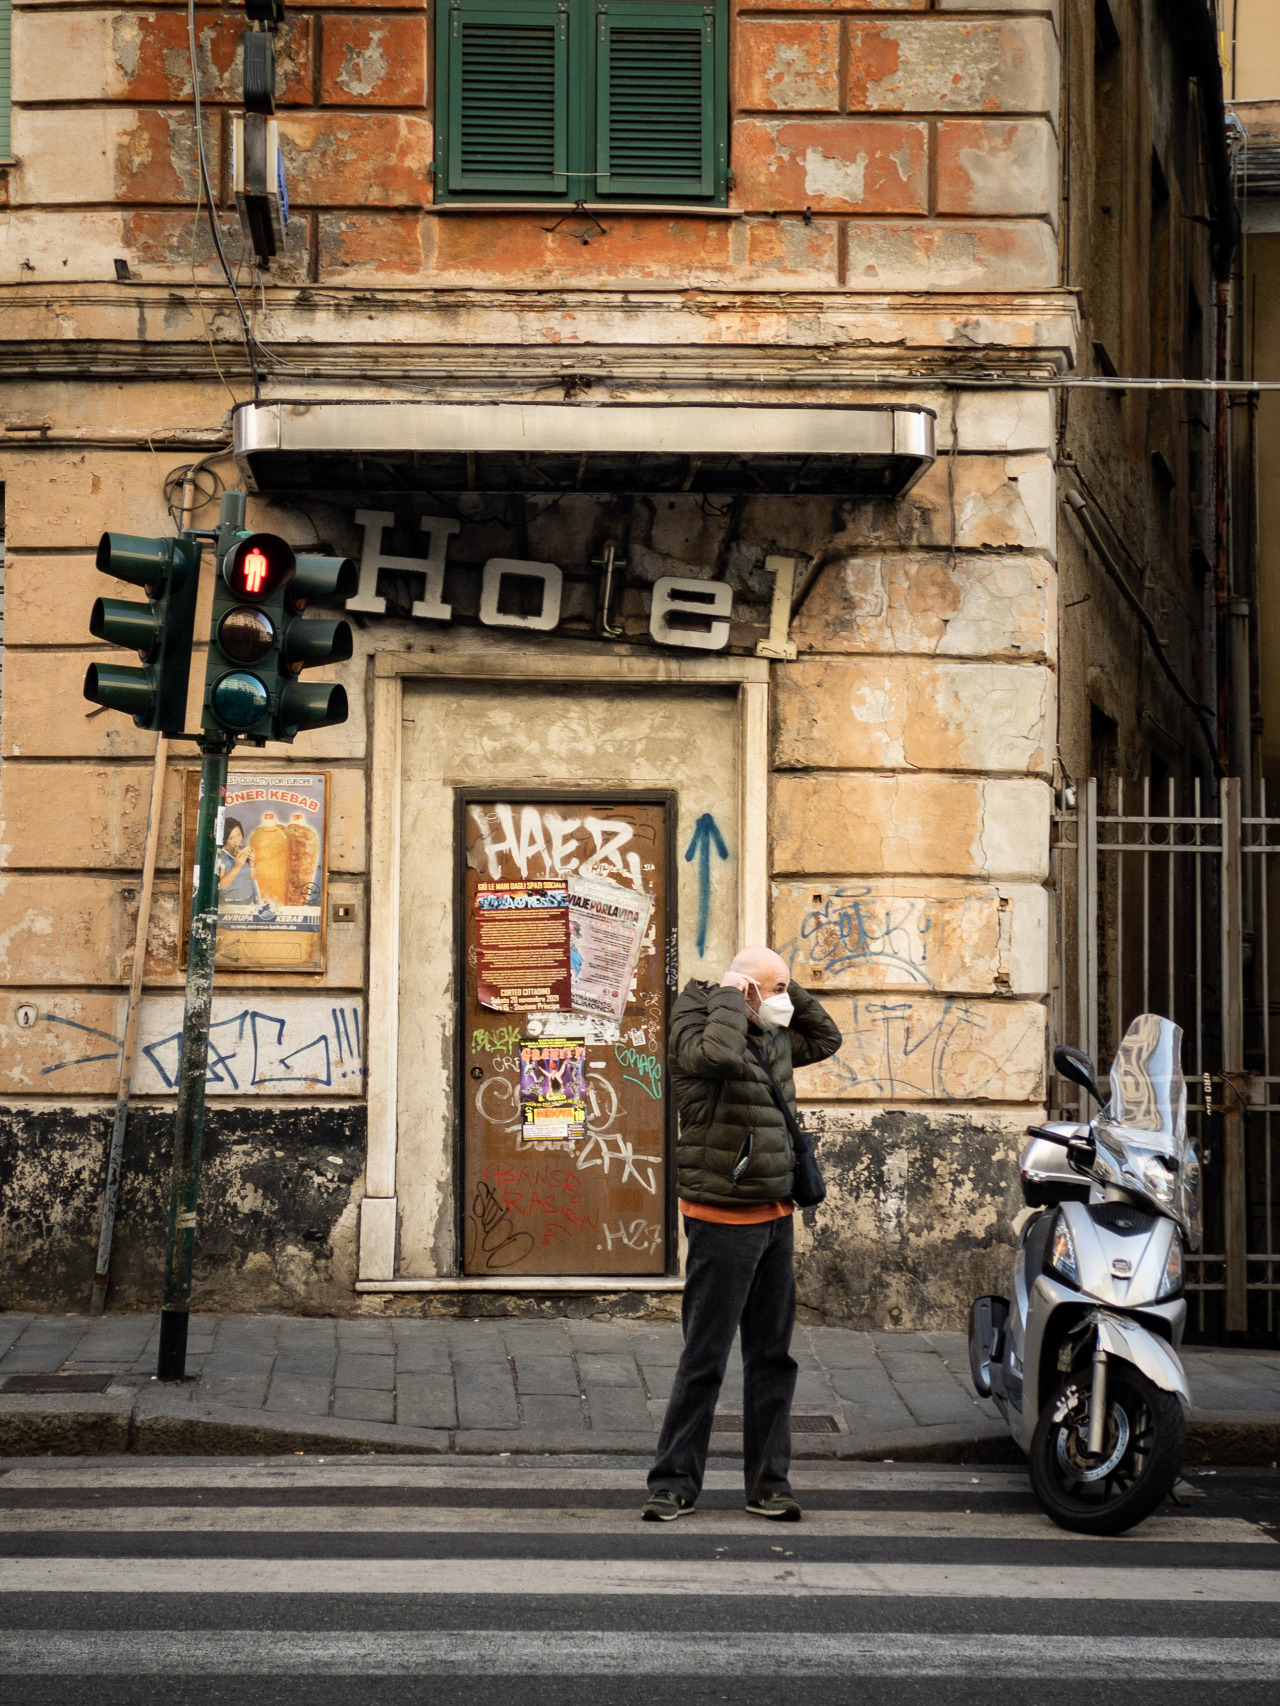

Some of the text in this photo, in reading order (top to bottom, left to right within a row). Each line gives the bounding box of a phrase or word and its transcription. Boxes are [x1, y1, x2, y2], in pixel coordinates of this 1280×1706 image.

[345, 508, 797, 660] Hotel
[226, 776, 312, 786] EST QUALITY FOR EUROPE
[225, 789, 319, 811] ÖNER KEBAB
[222, 914, 304, 923] AVRUPA KEBAB
